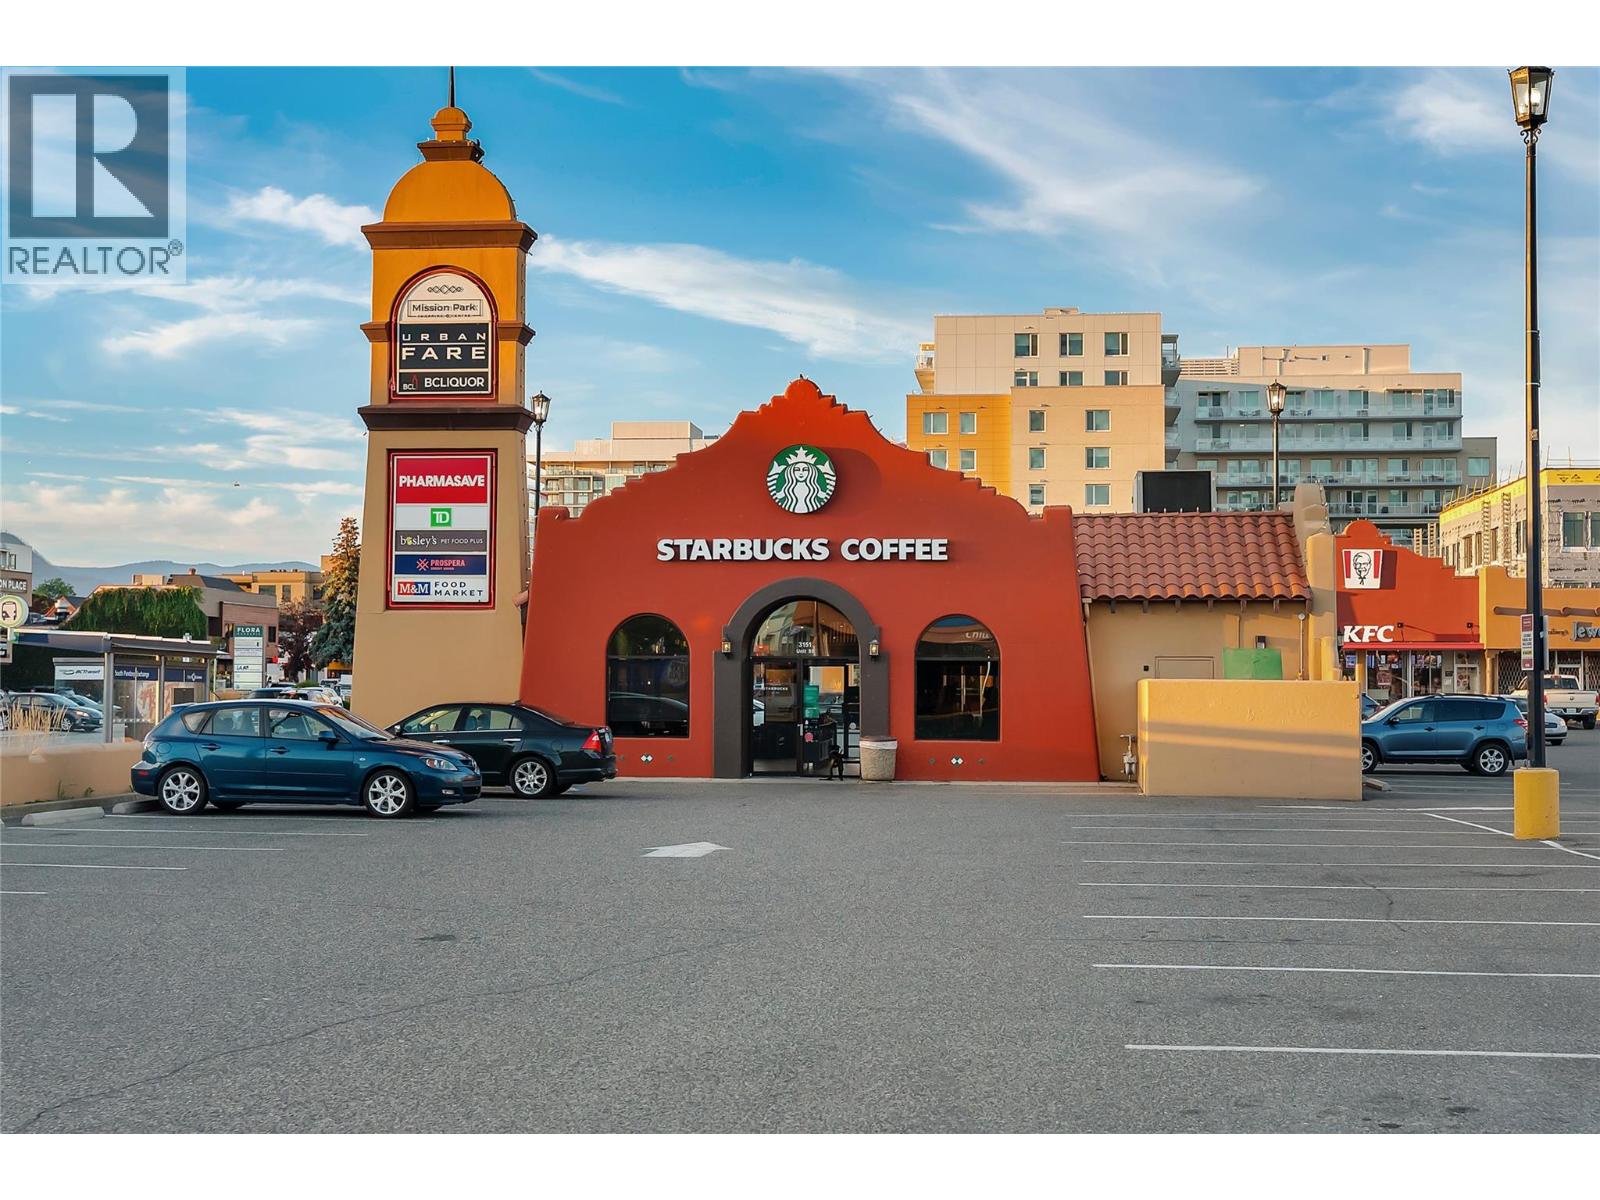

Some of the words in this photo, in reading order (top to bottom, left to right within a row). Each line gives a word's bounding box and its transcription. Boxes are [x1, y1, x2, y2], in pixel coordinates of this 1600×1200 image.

[412, 303, 450, 312] Mission
[452, 303, 477, 311] Park
[402, 332, 486, 341] URBAN
[401, 346, 486, 360] FARE
[399, 475, 485, 487] PHARMASAVE
[433, 511, 450, 524] TD
[400, 535, 437, 548] bosley's
[656, 538, 830, 561] STARBUCKS
[840, 538, 948, 561] COFFEE
[430, 559, 466, 567] PROSPERA
[8, 580, 27, 590] PLACE
[399, 583, 429, 594] M&M
[1343, 625, 1395, 643] KFC
